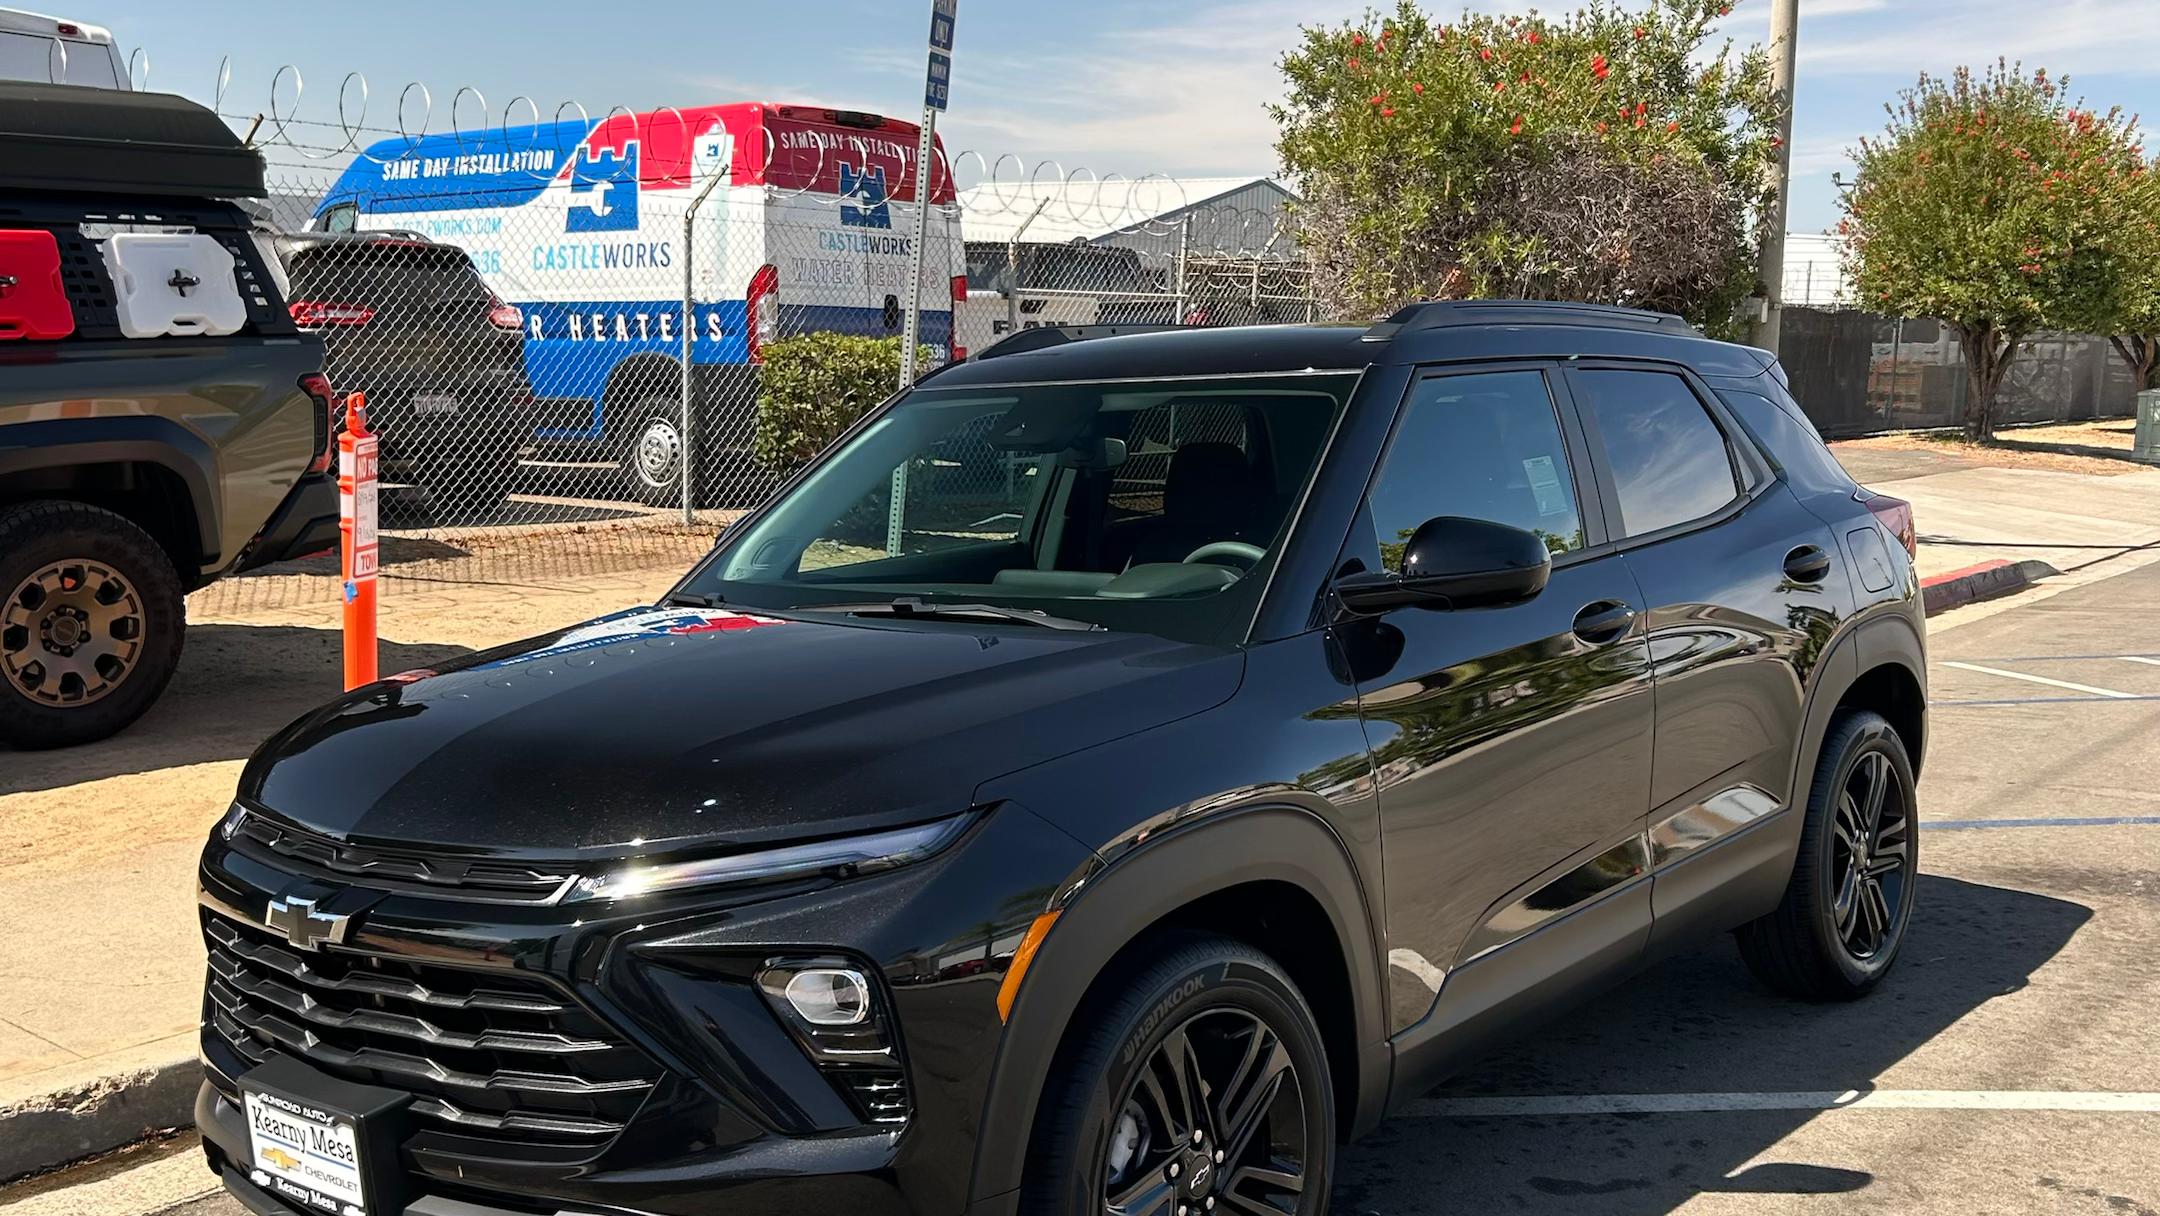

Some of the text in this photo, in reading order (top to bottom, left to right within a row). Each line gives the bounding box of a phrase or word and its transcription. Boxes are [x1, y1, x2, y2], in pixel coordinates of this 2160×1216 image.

[780, 131, 818, 150] SAME
[821, 132, 844, 151] DAY
[382, 150, 555, 181] SAME DAY INSTALLATION
[532, 242, 671, 271] CASTLEWORKS
[791, 257, 939, 289] WATER HEATRS
[251, 1104, 355, 1163] Kearny Mesa
[276, 1177, 338, 1211] Kearny Mesa
[304, 1166, 358, 1192] CHEVROLET
